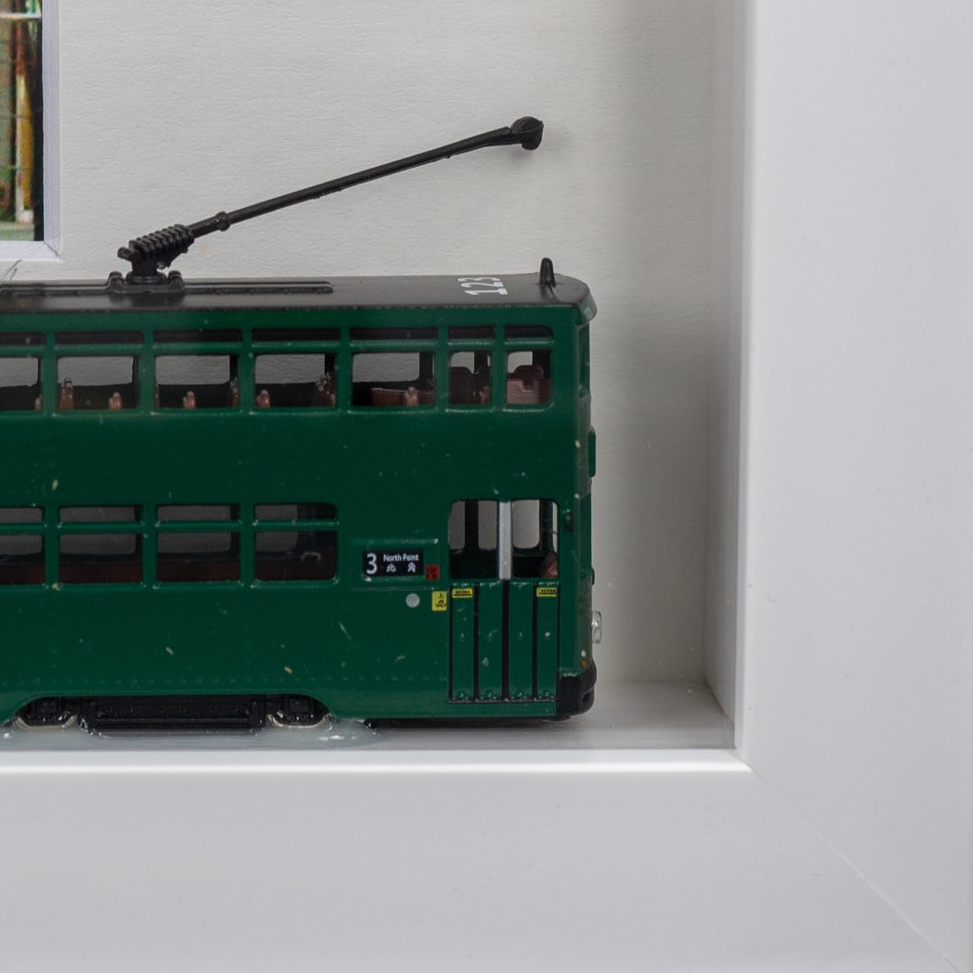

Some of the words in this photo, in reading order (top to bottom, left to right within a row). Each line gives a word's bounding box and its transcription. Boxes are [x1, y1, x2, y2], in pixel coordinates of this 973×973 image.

[457, 276, 508, 296] 123
[365, 552, 378, 575] 3
[382, 553, 402, 562] North
[402, 552, 419, 562] Point
